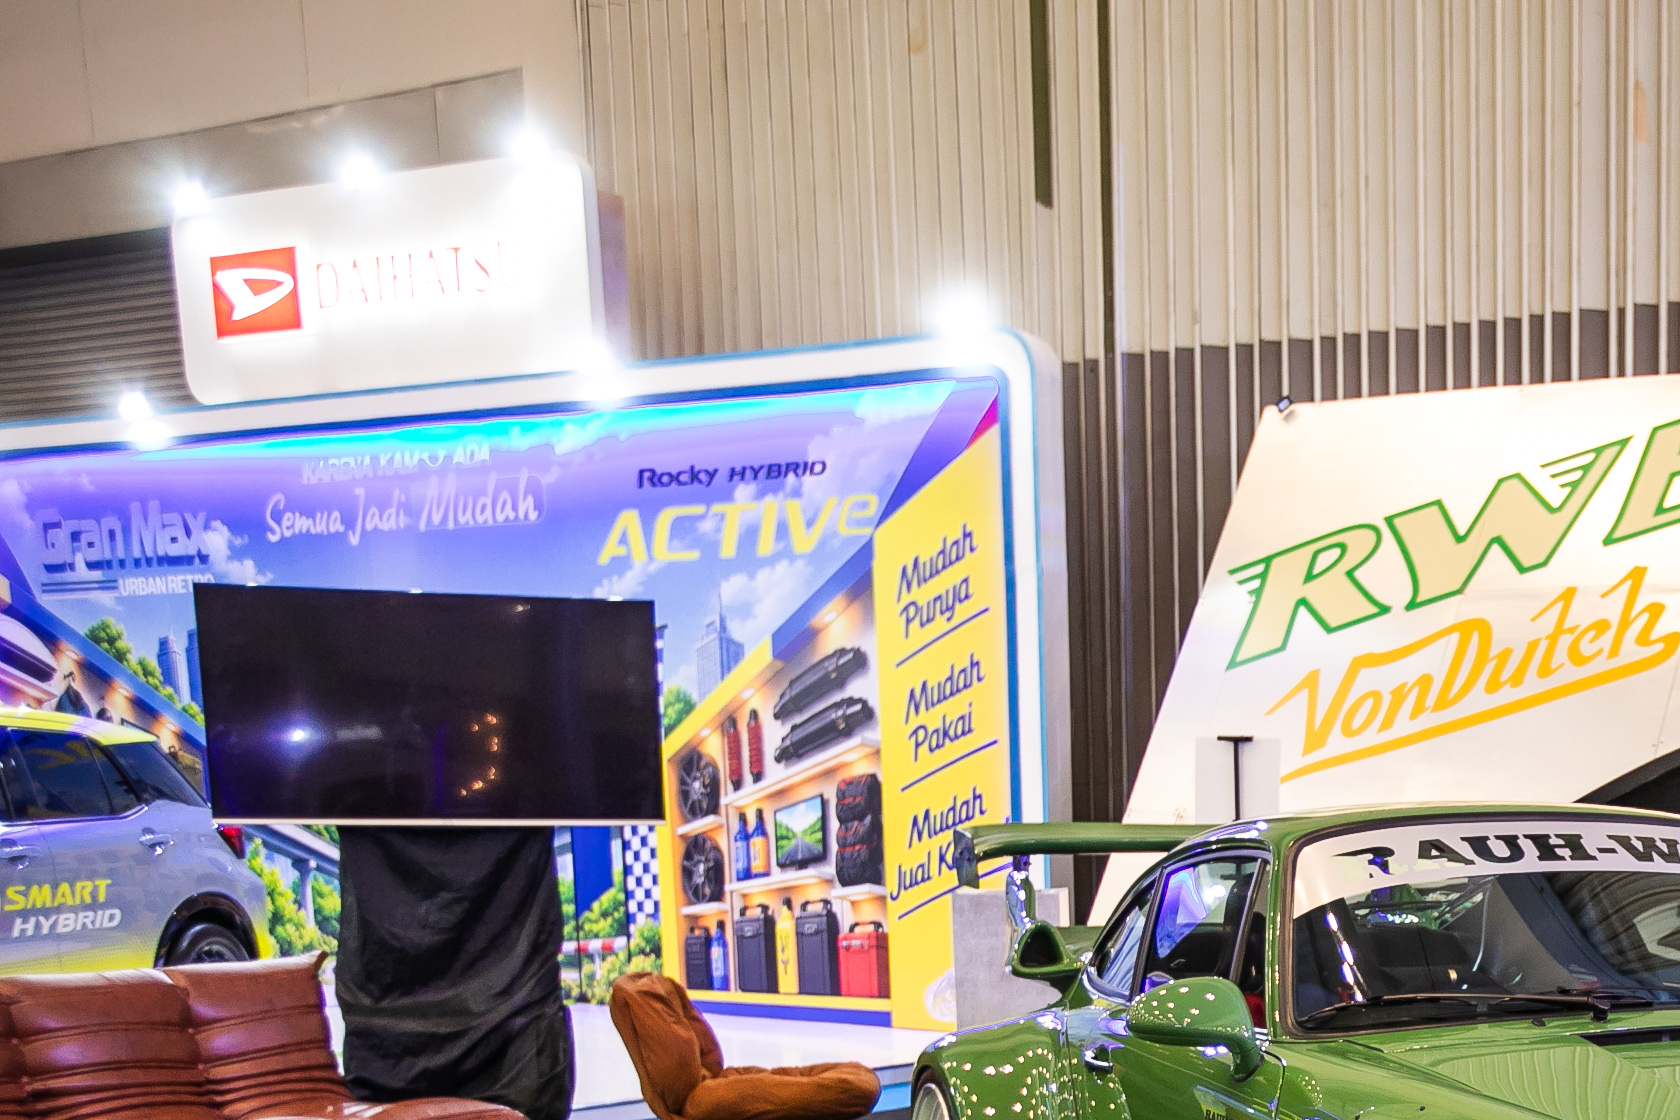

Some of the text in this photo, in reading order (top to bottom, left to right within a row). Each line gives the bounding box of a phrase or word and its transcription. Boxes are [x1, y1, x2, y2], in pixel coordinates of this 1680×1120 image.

[452, 442, 491, 468] ADA
[637, 460, 827, 489] Rocky HYBRID
[36, 499, 211, 574] Gran Max
[265, 467, 540, 547] Semua Jadi Mudah
[118, 576, 167, 597] URBAN
[896, 522, 978, 604] Mudah
[899, 574, 974, 640] Punya
[904, 652, 985, 725] Mudah
[908, 701, 975, 763] Pakai
[908, 784, 988, 850] Mudah
[4, 878, 112, 911] SMART
[889, 850, 933, 901] Jual
[12, 908, 122, 938] HYBRID
